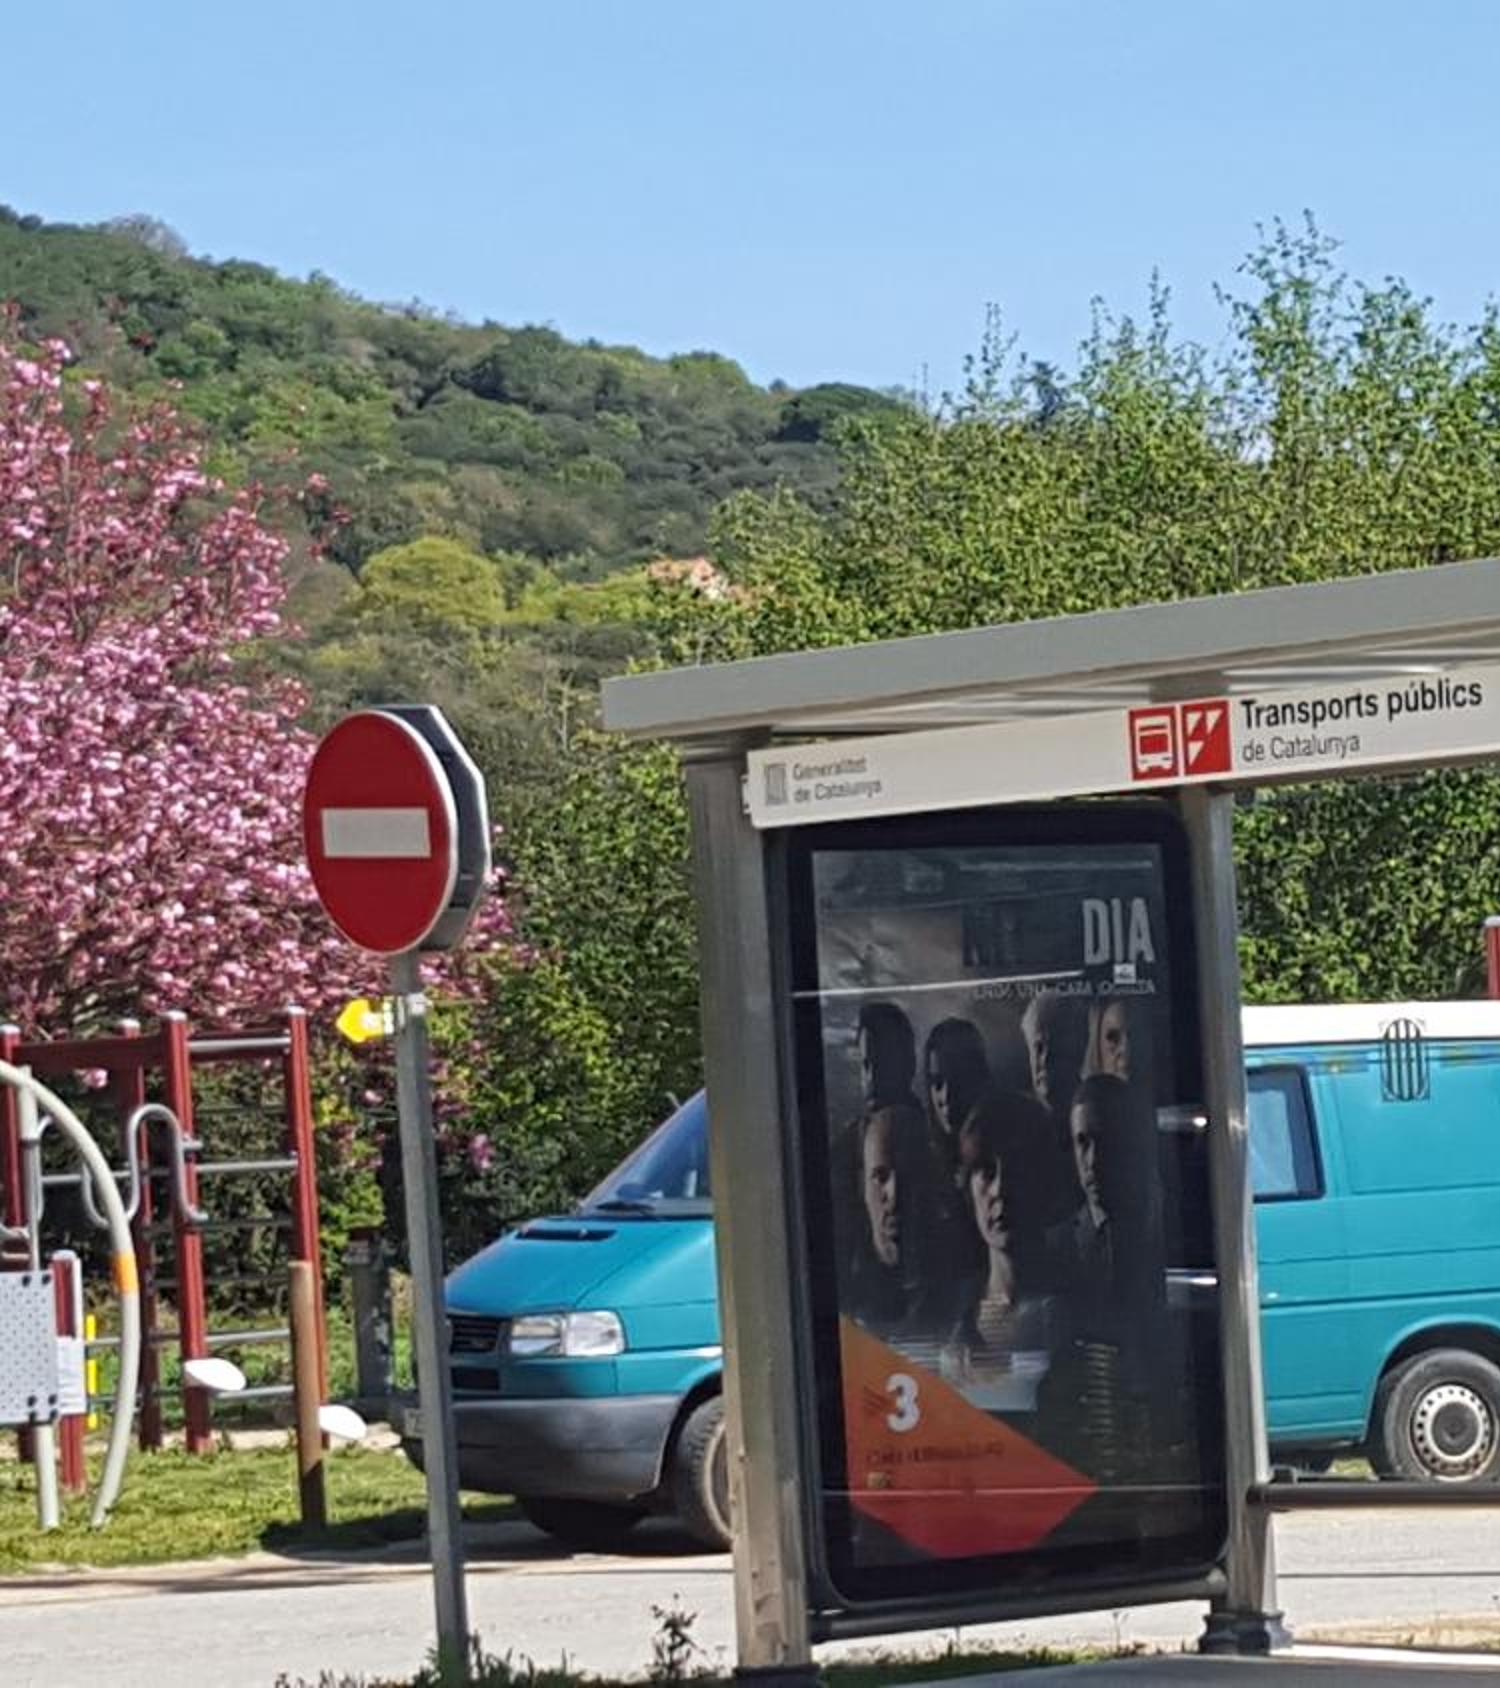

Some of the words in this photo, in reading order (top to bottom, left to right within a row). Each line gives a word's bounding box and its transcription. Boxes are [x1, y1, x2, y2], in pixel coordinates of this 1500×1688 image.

[1241, 690, 1379, 730] Transports
[1386, 679, 1483, 722] públics
[1242, 741, 1266, 763] de
[1270, 731, 1361, 760] Catalunya
[792, 757, 867, 780] Generalitat
[792, 786, 811, 803] de
[815, 777, 883, 804] Catalunya
[1082, 896, 1157, 966] DIA
[885, 1372, 922, 1433] 3
